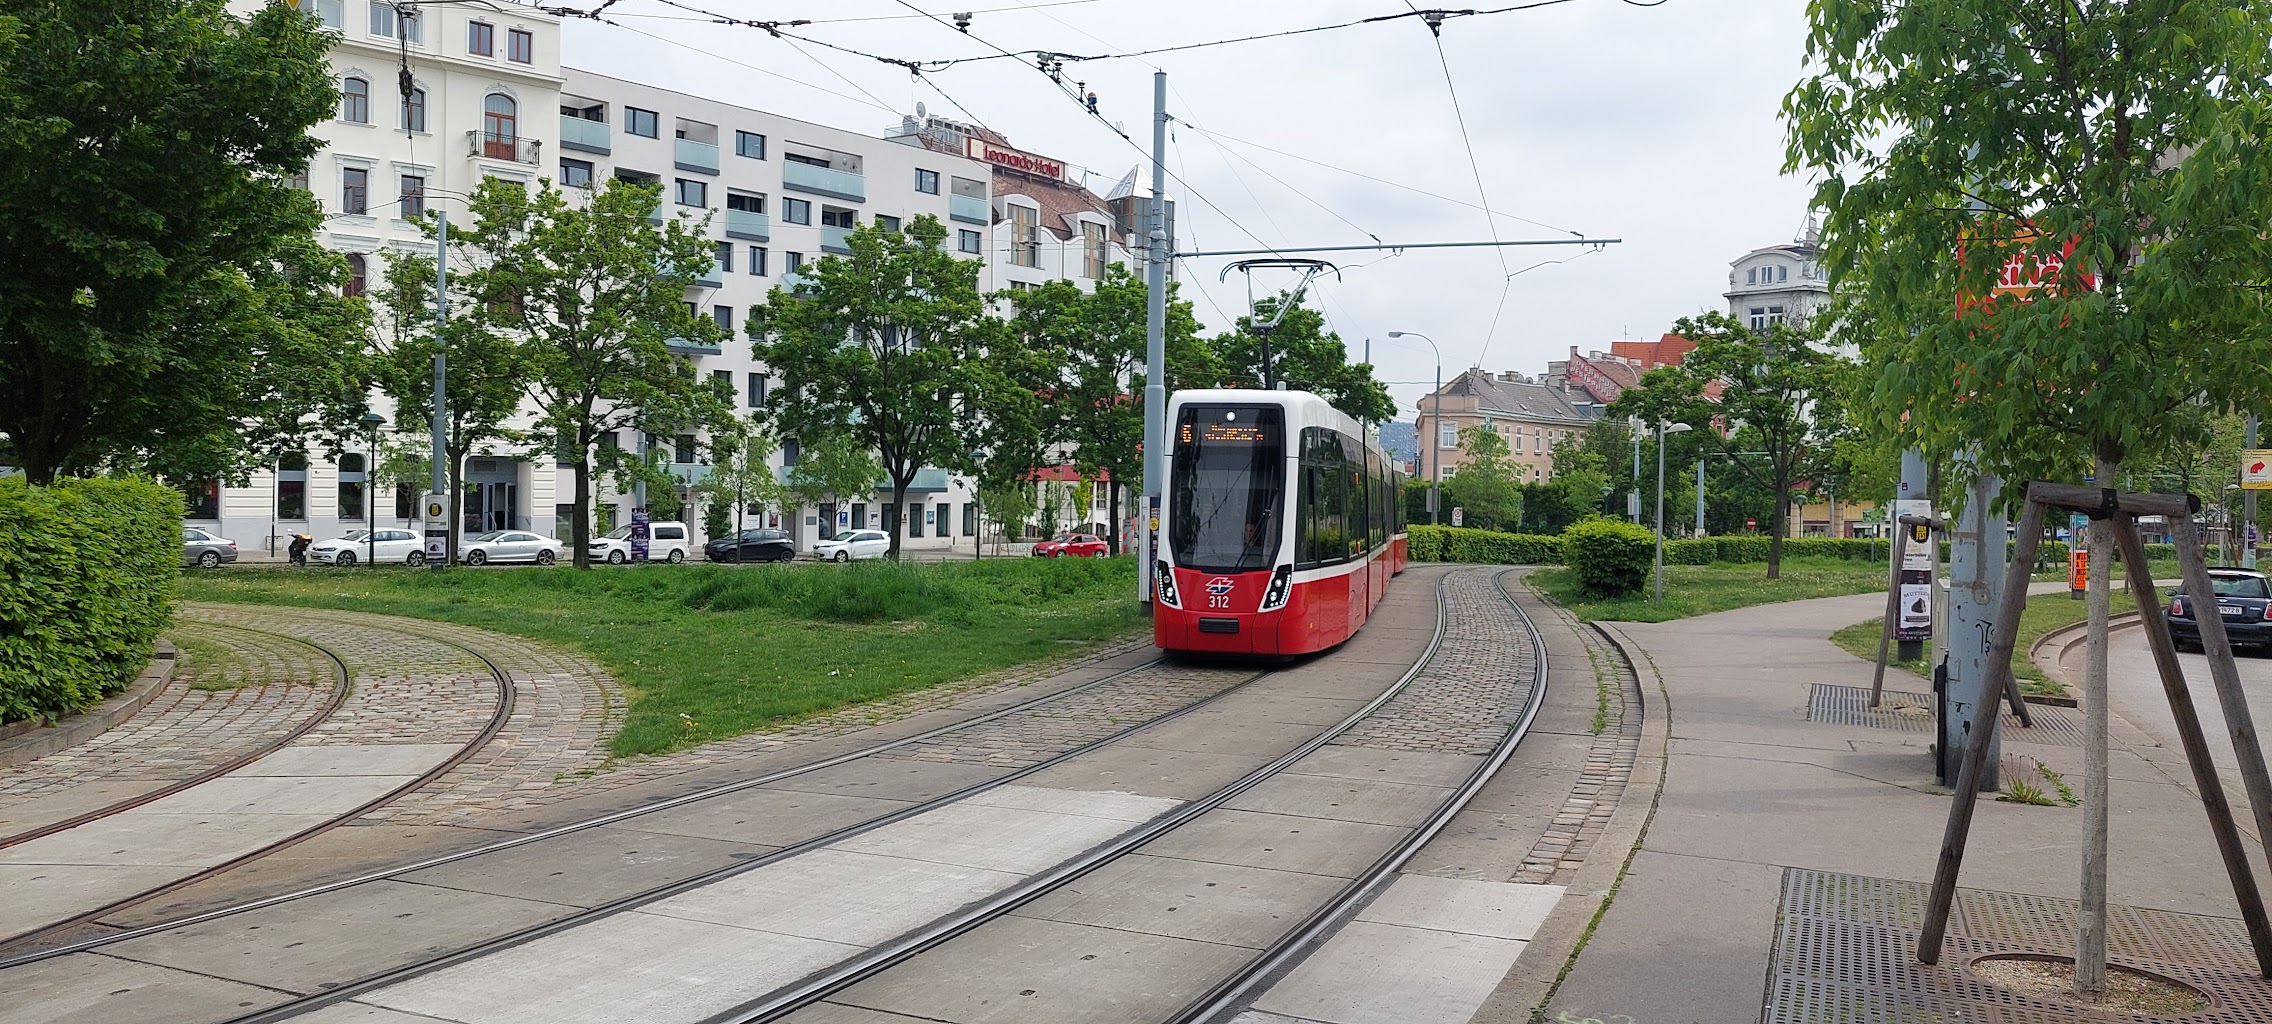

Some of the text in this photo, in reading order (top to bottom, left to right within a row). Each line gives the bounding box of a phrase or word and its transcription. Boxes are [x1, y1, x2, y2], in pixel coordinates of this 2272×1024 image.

[983, 145, 1060, 177] Leonardo Hotel
[1183, 424, 1192, 442] 6
[1208, 595, 1230, 608] 312
